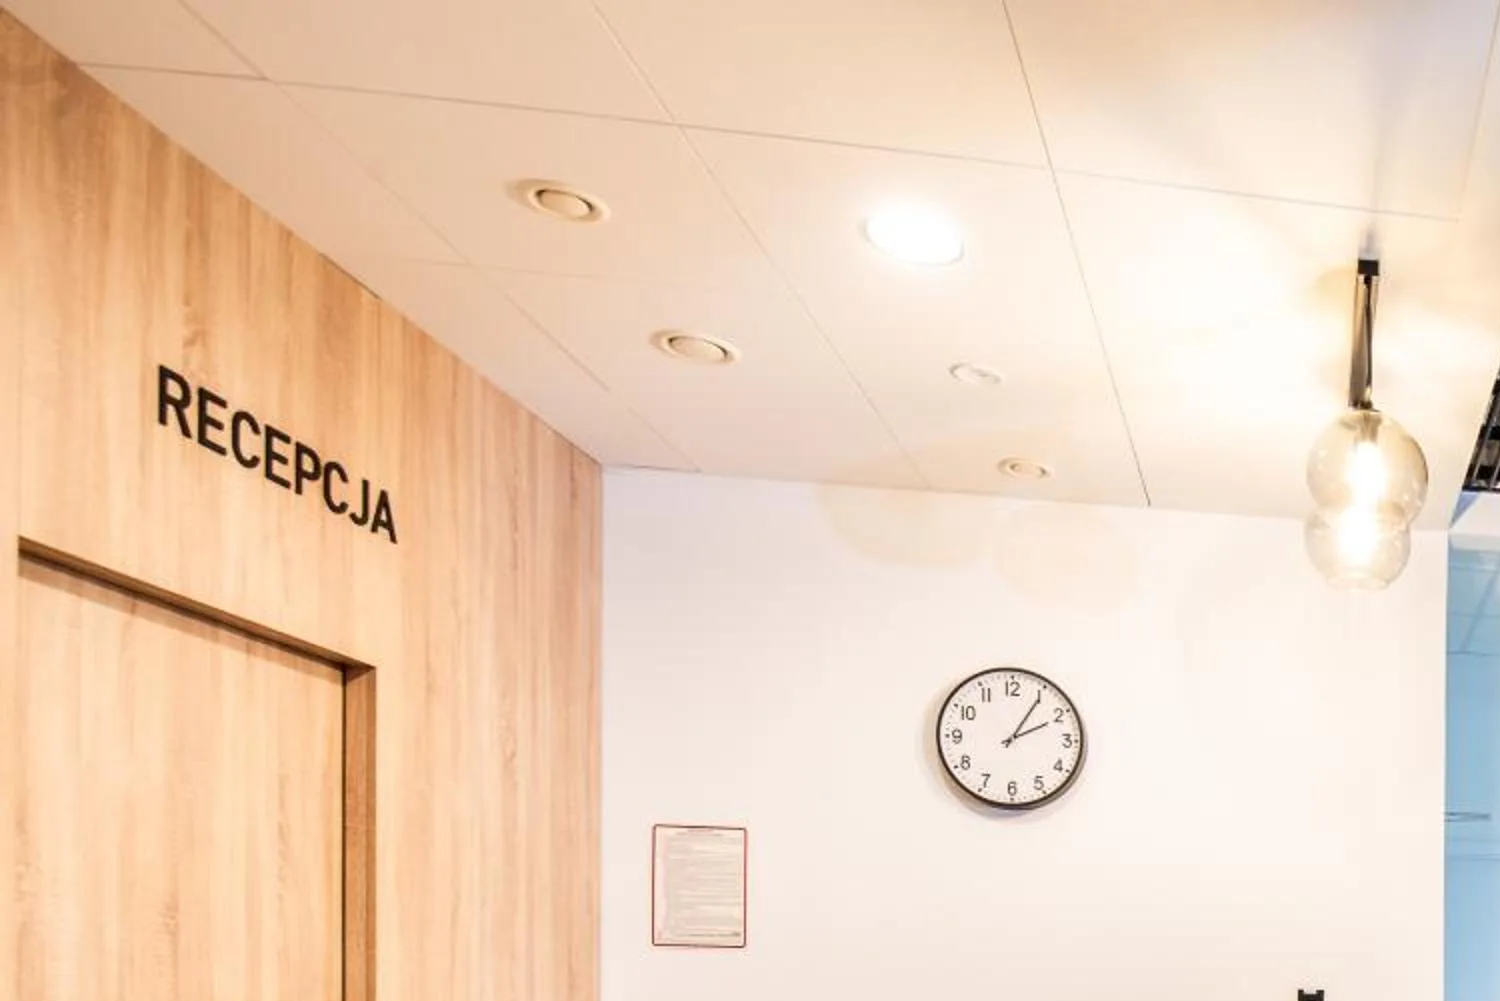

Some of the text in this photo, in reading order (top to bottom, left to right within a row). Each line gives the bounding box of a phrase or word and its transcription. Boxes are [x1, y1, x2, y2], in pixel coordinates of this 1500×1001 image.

[158, 364, 398, 544] RECEPCJA
[981, 687, 991, 703] 11
[1005, 681, 1020, 697] 12
[961, 705, 976, 721] 10
[1053, 708, 1064, 723] 2
[952, 729, 962, 744] 9
[1062, 733, 1073, 748] 3
[960, 755, 971, 770] 8
[1053, 760, 1063, 773] 4
[981, 774, 991, 788] 7
[1007, 781, 1018, 796] 6
[1033, 776, 1044, 790] 5
